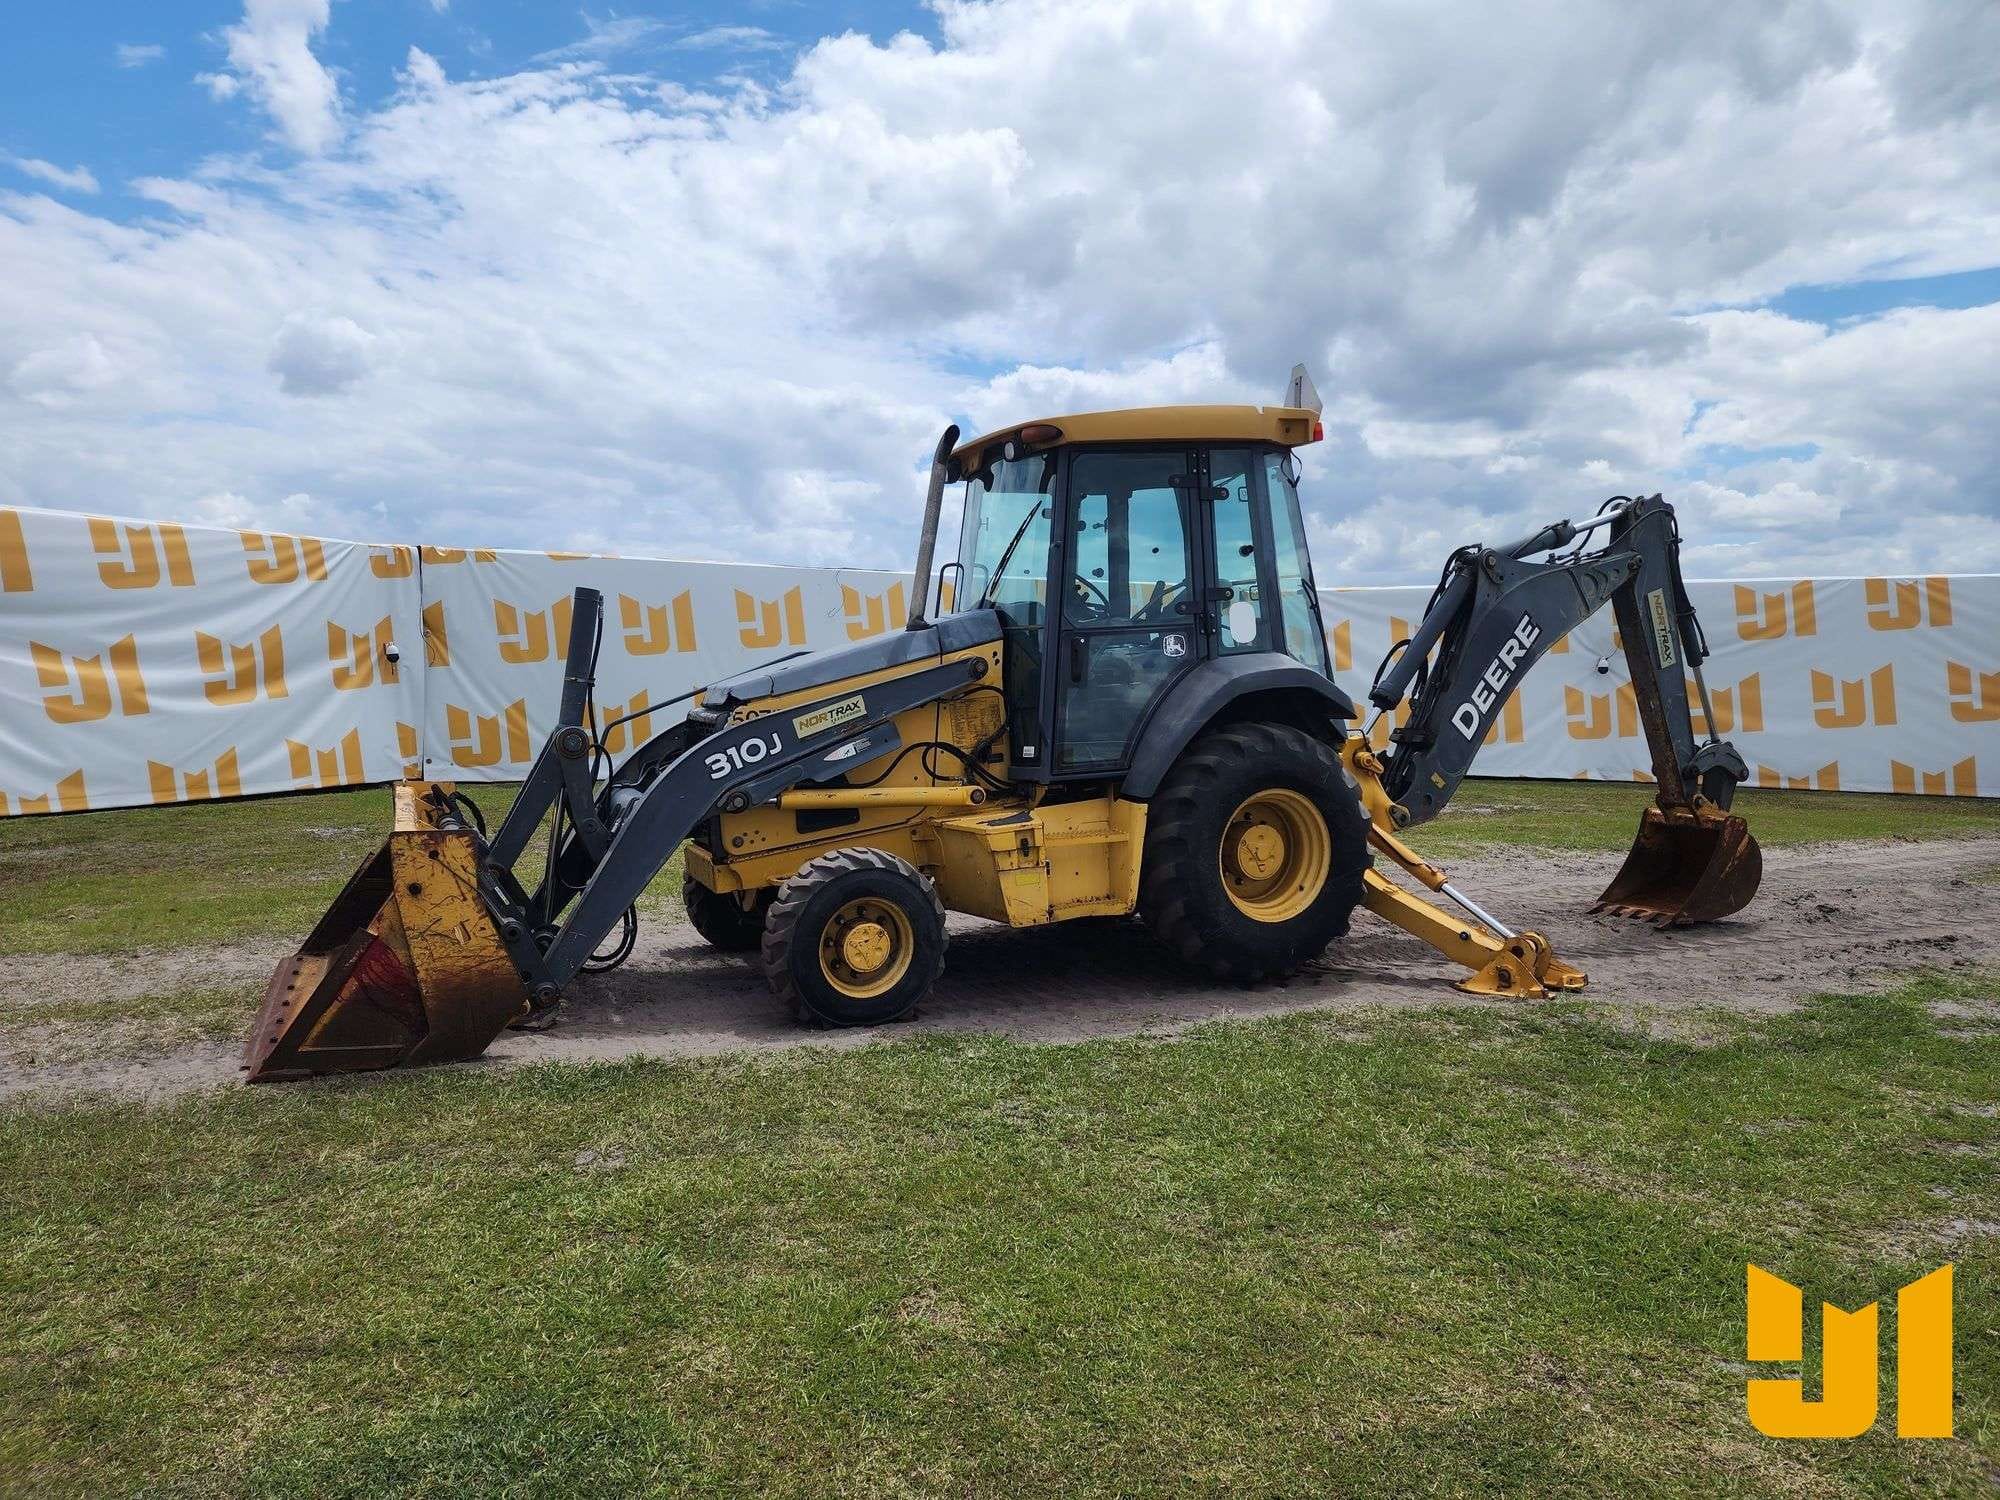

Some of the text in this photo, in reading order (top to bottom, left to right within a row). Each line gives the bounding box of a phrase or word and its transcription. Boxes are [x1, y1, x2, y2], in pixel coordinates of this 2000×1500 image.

[1653, 594, 1672, 661] NORTRAX
[1451, 614, 1541, 741] DEERE
[798, 699, 861, 730] NORTRAX
[704, 732, 783, 780] 310J
